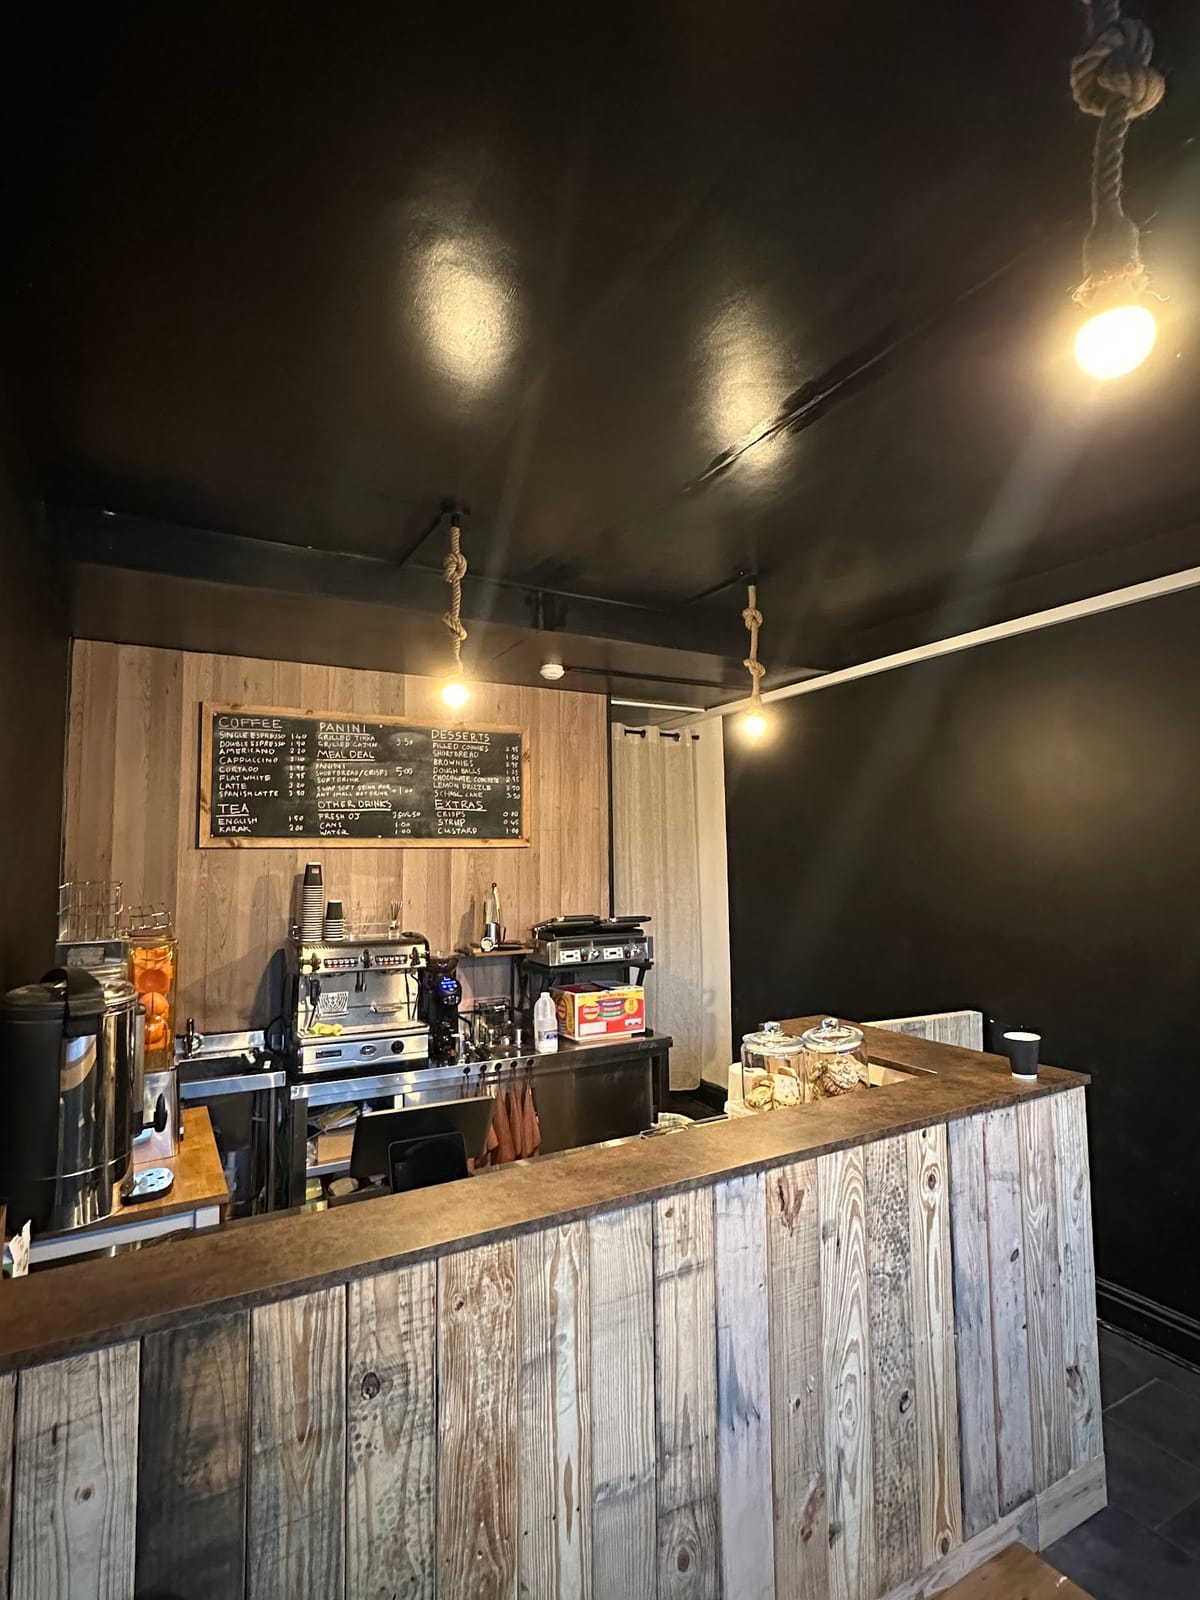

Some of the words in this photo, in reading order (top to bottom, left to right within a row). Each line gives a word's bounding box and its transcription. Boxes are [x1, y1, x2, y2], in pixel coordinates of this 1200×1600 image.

[219, 717, 283, 728] COFFEE
[320, 722, 366, 732] PANINI
[220, 731, 248, 739] SINGLE
[432, 730, 490, 742] DESSERTS
[317, 750, 346, 758] MEAL
[350, 750, 374, 758] DEAL
[432, 750, 479, 758] SHORTBREAD
[434, 759, 474, 767] BROWNIES
[318, 800, 356, 808] OTHER
[358, 800, 392, 808] DRINKS
[435, 800, 483, 809] EXTRAS
[217, 803, 250, 814] TEA
[438, 818, 465, 826] SYRUP
